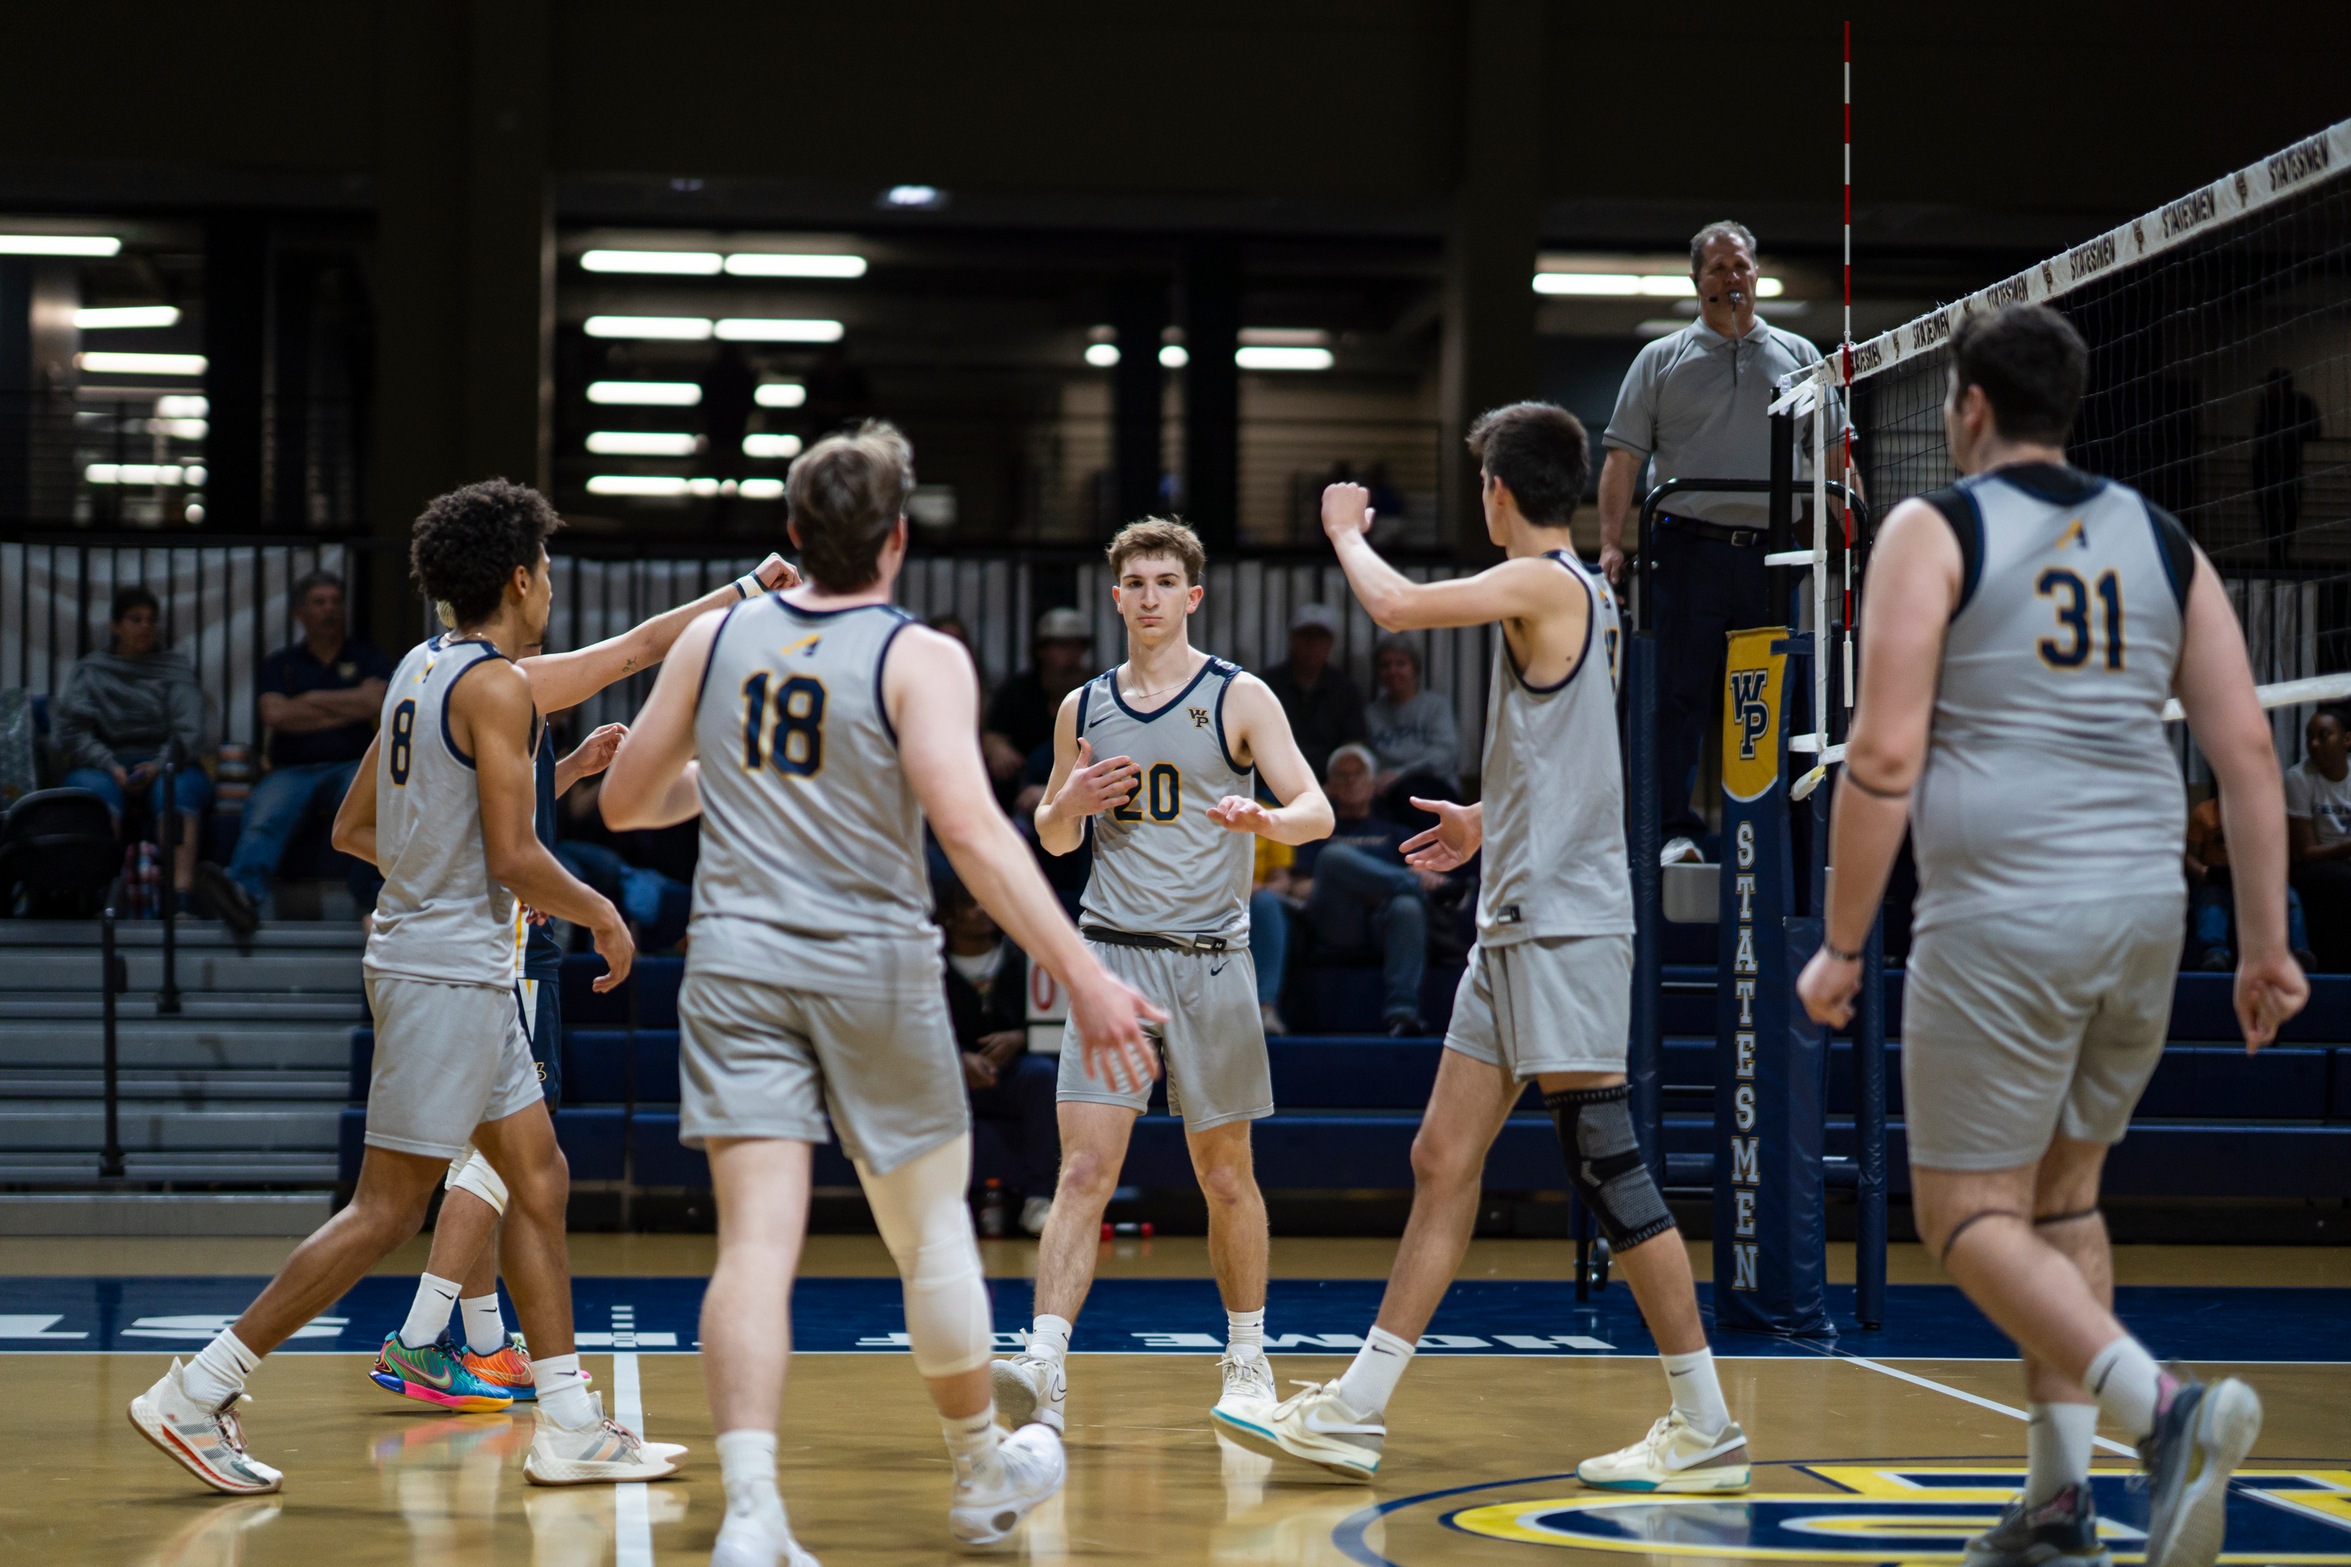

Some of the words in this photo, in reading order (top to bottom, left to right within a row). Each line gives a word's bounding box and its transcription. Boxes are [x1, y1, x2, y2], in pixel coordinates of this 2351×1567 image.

[1913, 309, 1950, 350] STATEMEN
[2069, 233, 2116, 281] STATESMEN
[2161, 186, 2216, 239] STATESMEN
[2268, 132, 2330, 192] STATESMEN
[2036, 567, 2124, 670] 31
[389, 697, 417, 787] 8
[740, 671, 828, 782] 18
[1187, 706, 1210, 729] WP
[1729, 668, 1768, 760] WP
[1113, 761, 1183, 824] 20
[1731, 819, 1761, 1293] STATESMEN
